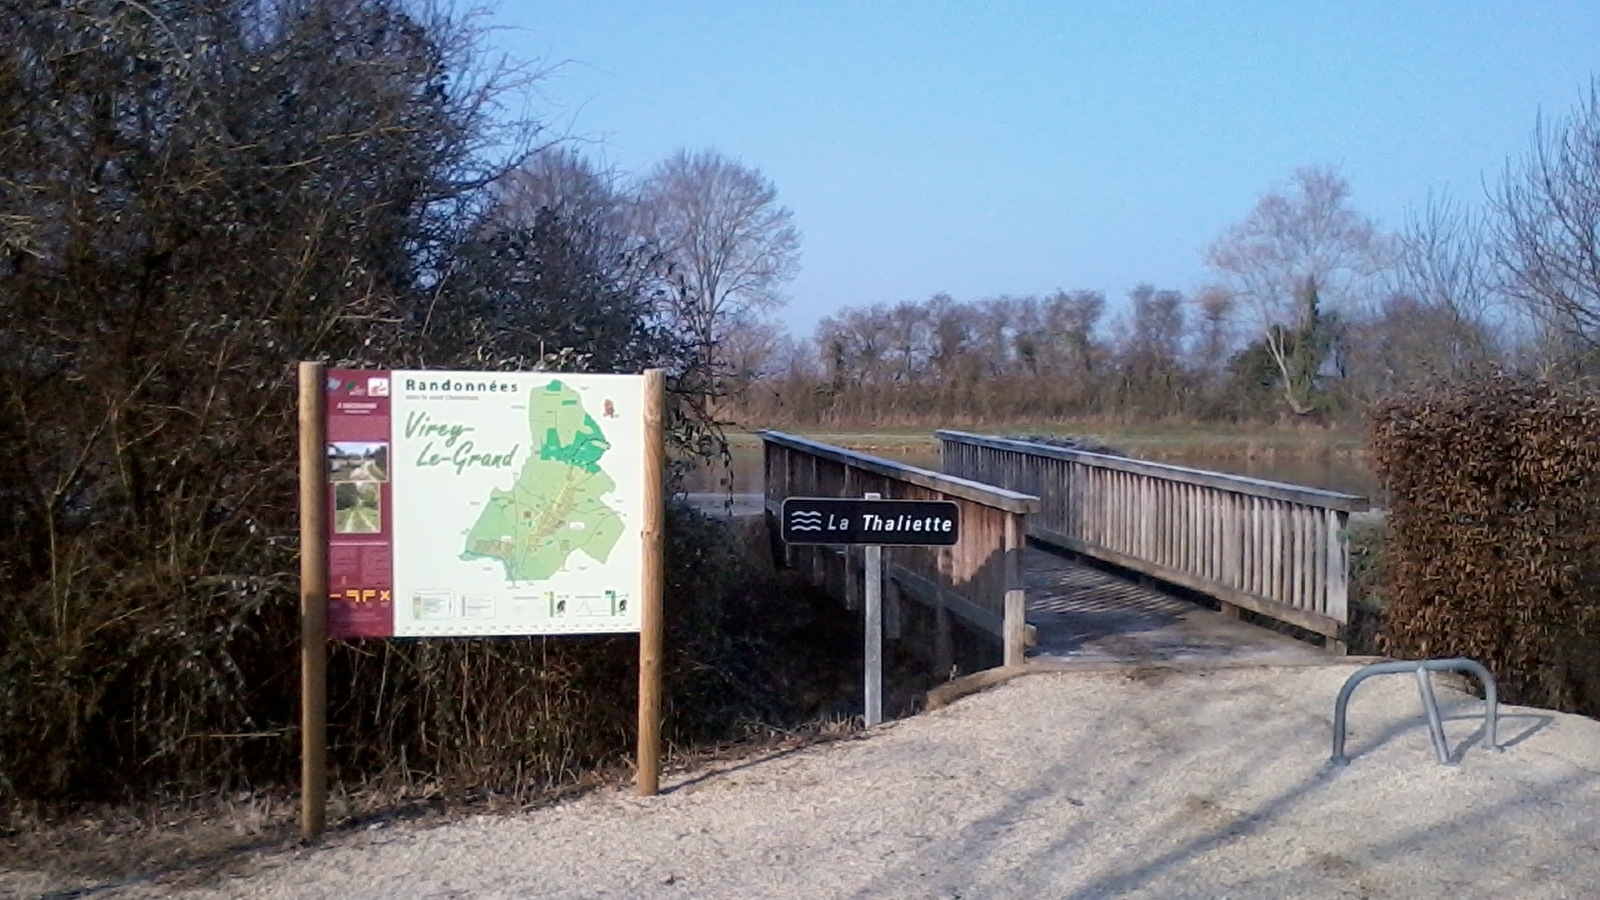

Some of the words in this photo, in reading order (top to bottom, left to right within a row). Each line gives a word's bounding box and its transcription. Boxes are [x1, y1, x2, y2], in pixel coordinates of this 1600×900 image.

[405, 379, 518, 392] Randonnées
[416, 441, 519, 476] Le-Grand
[827, 514, 849, 531] La
[862, 514, 952, 532] Thaliette
